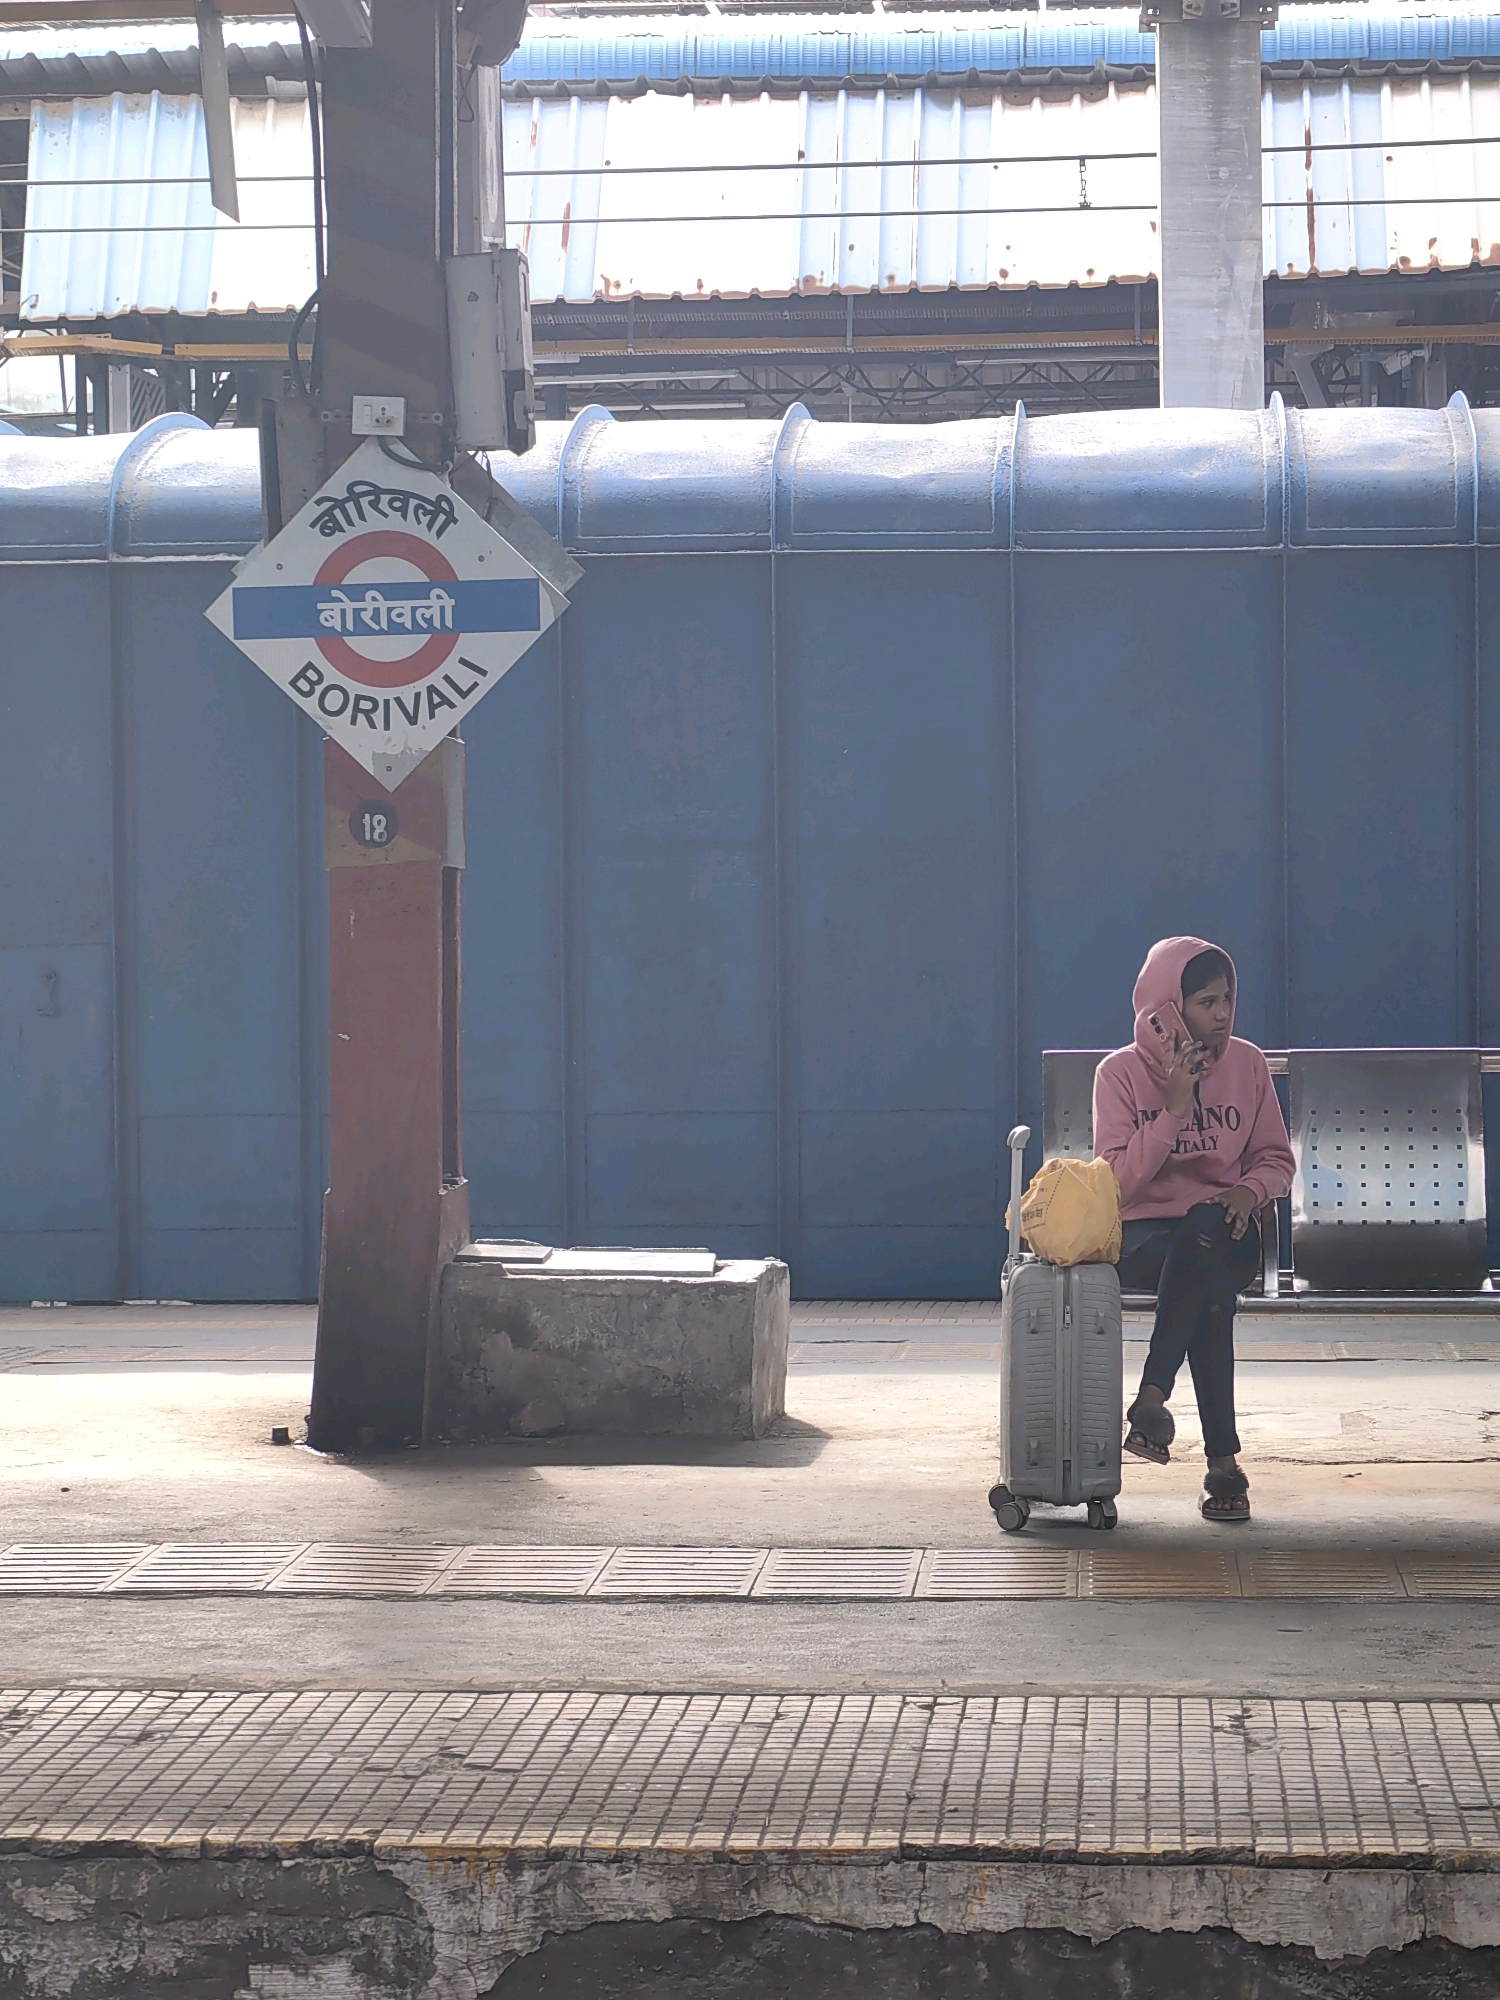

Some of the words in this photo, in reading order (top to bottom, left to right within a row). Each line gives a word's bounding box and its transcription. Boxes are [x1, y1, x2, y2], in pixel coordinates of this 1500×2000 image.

[308, 479, 459, 541] बोरिवली
[316, 587, 456, 633] बोरीवली
[288, 656, 489, 732] BORIVALI
[362, 813, 388, 842] 18
[1138, 1104, 1241, 1132] MANO
